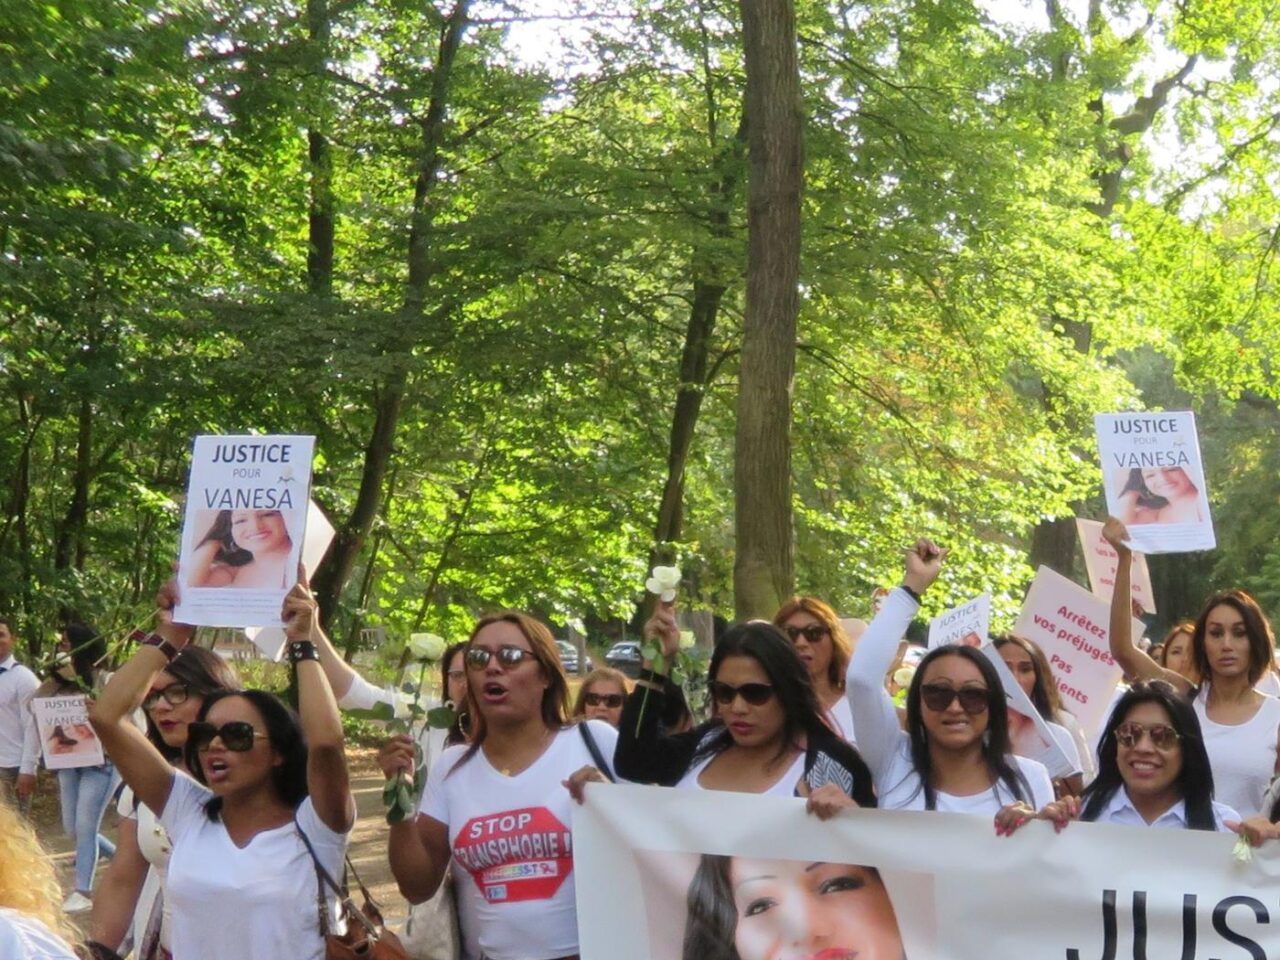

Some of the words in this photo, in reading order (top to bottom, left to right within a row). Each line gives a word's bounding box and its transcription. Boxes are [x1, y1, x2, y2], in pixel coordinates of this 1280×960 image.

[1113, 418, 1178, 434] JUSTICE
[212, 444, 292, 463] JUSTICE
[1114, 450, 1190, 468] VANESA
[233, 468, 261, 478] POUR
[205, 488, 293, 509] VANESA
[1057, 605, 1107, 640] Arrêtez
[1034, 613, 1056, 633] vos
[1057, 627, 1116, 667] préjugés
[1050, 654, 1073, 674] Pas
[470, 813, 531, 838] STOP
